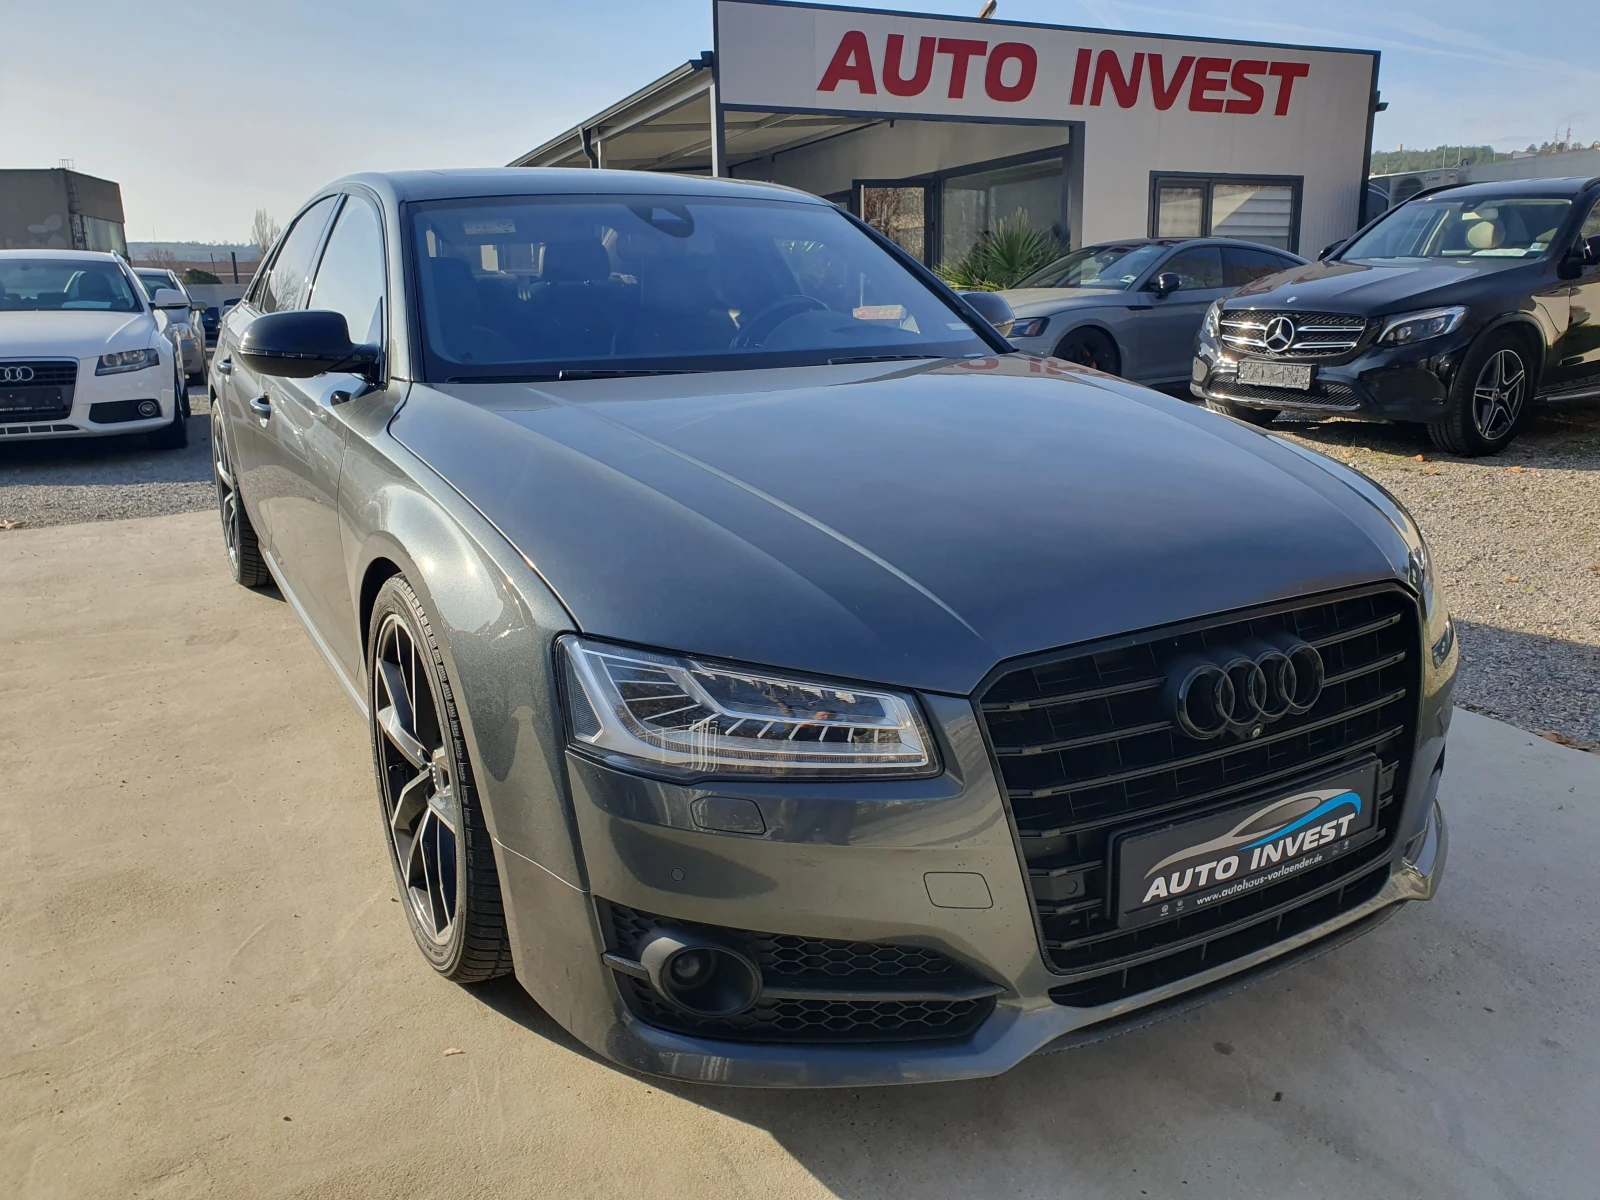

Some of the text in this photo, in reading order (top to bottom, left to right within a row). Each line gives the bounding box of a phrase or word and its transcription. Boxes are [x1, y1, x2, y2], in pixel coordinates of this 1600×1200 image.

[817, 30, 1310, 116] AUTO INVEST
[1142, 813, 1355, 903] AUTO INVEST
[1196, 854, 1323, 905] www.autohaus-vorlaender.de
